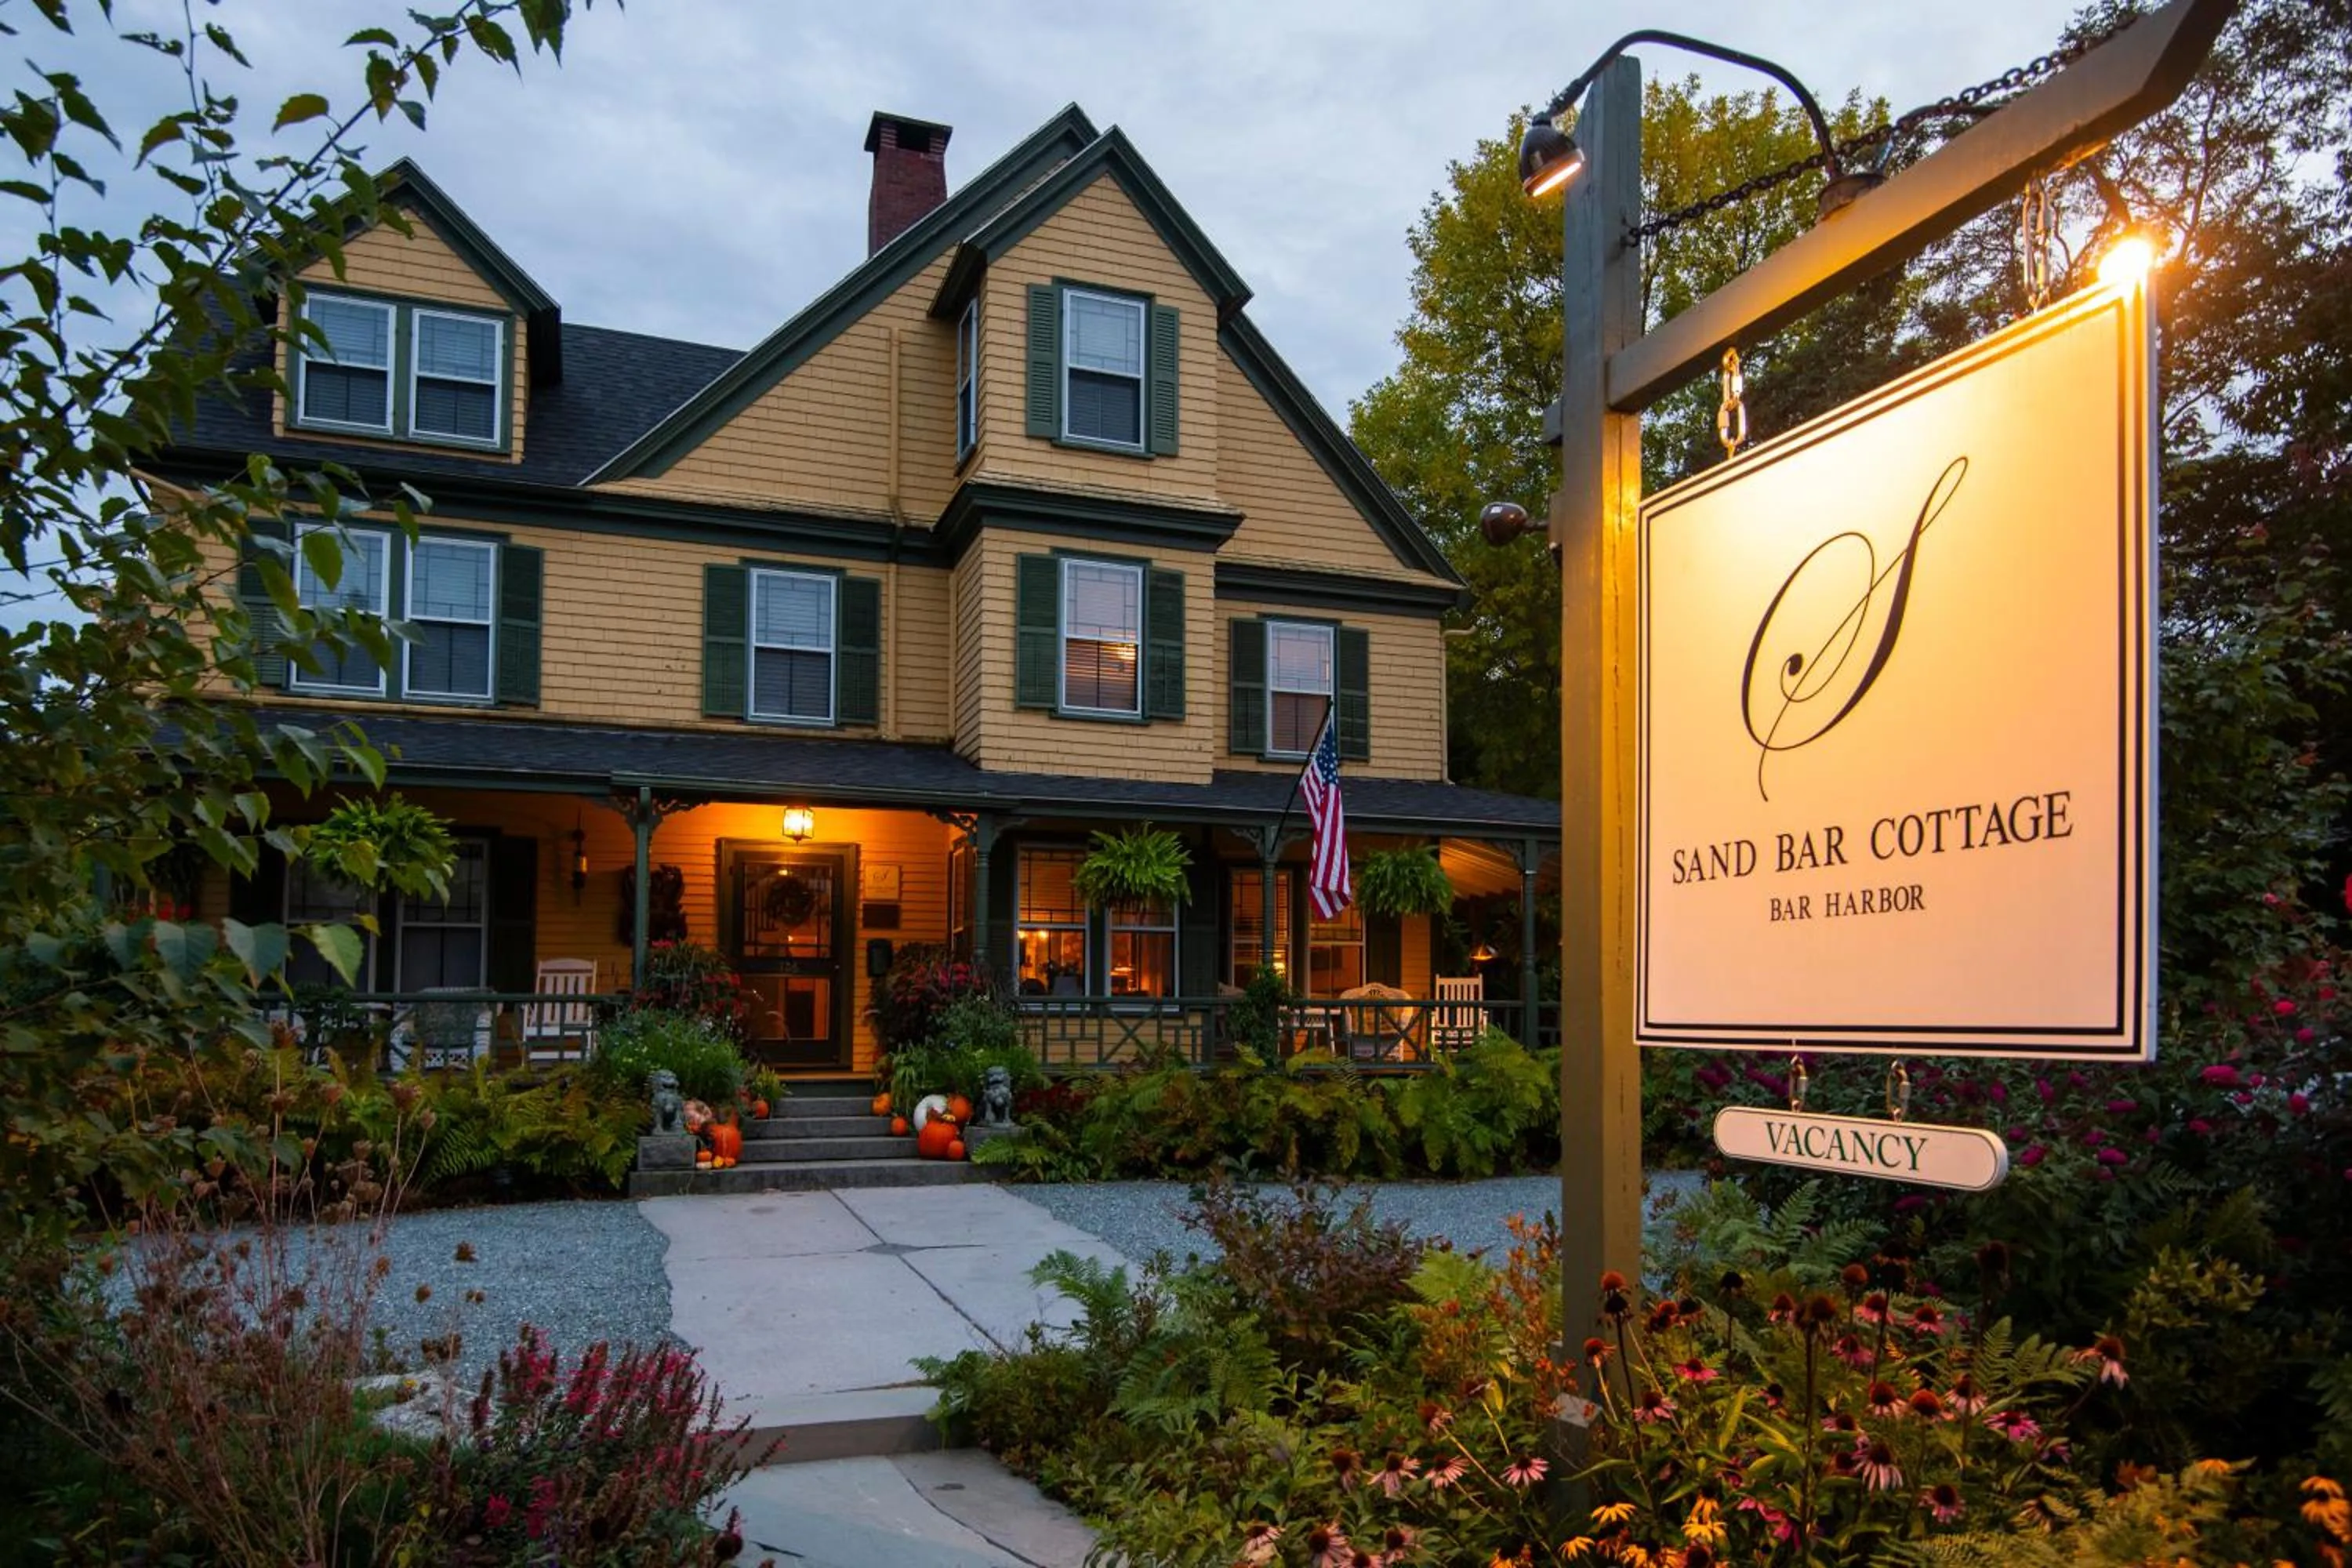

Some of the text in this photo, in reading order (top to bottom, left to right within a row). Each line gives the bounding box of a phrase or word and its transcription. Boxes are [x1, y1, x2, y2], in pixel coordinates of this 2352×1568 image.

[1741, 456, 1969, 802] S
[1672, 790, 2074, 885] SAND BAR COTTAGE
[1769, 884, 1926, 922] BAR HARBOR
[1765, 1122, 1927, 1171] VACANCY
